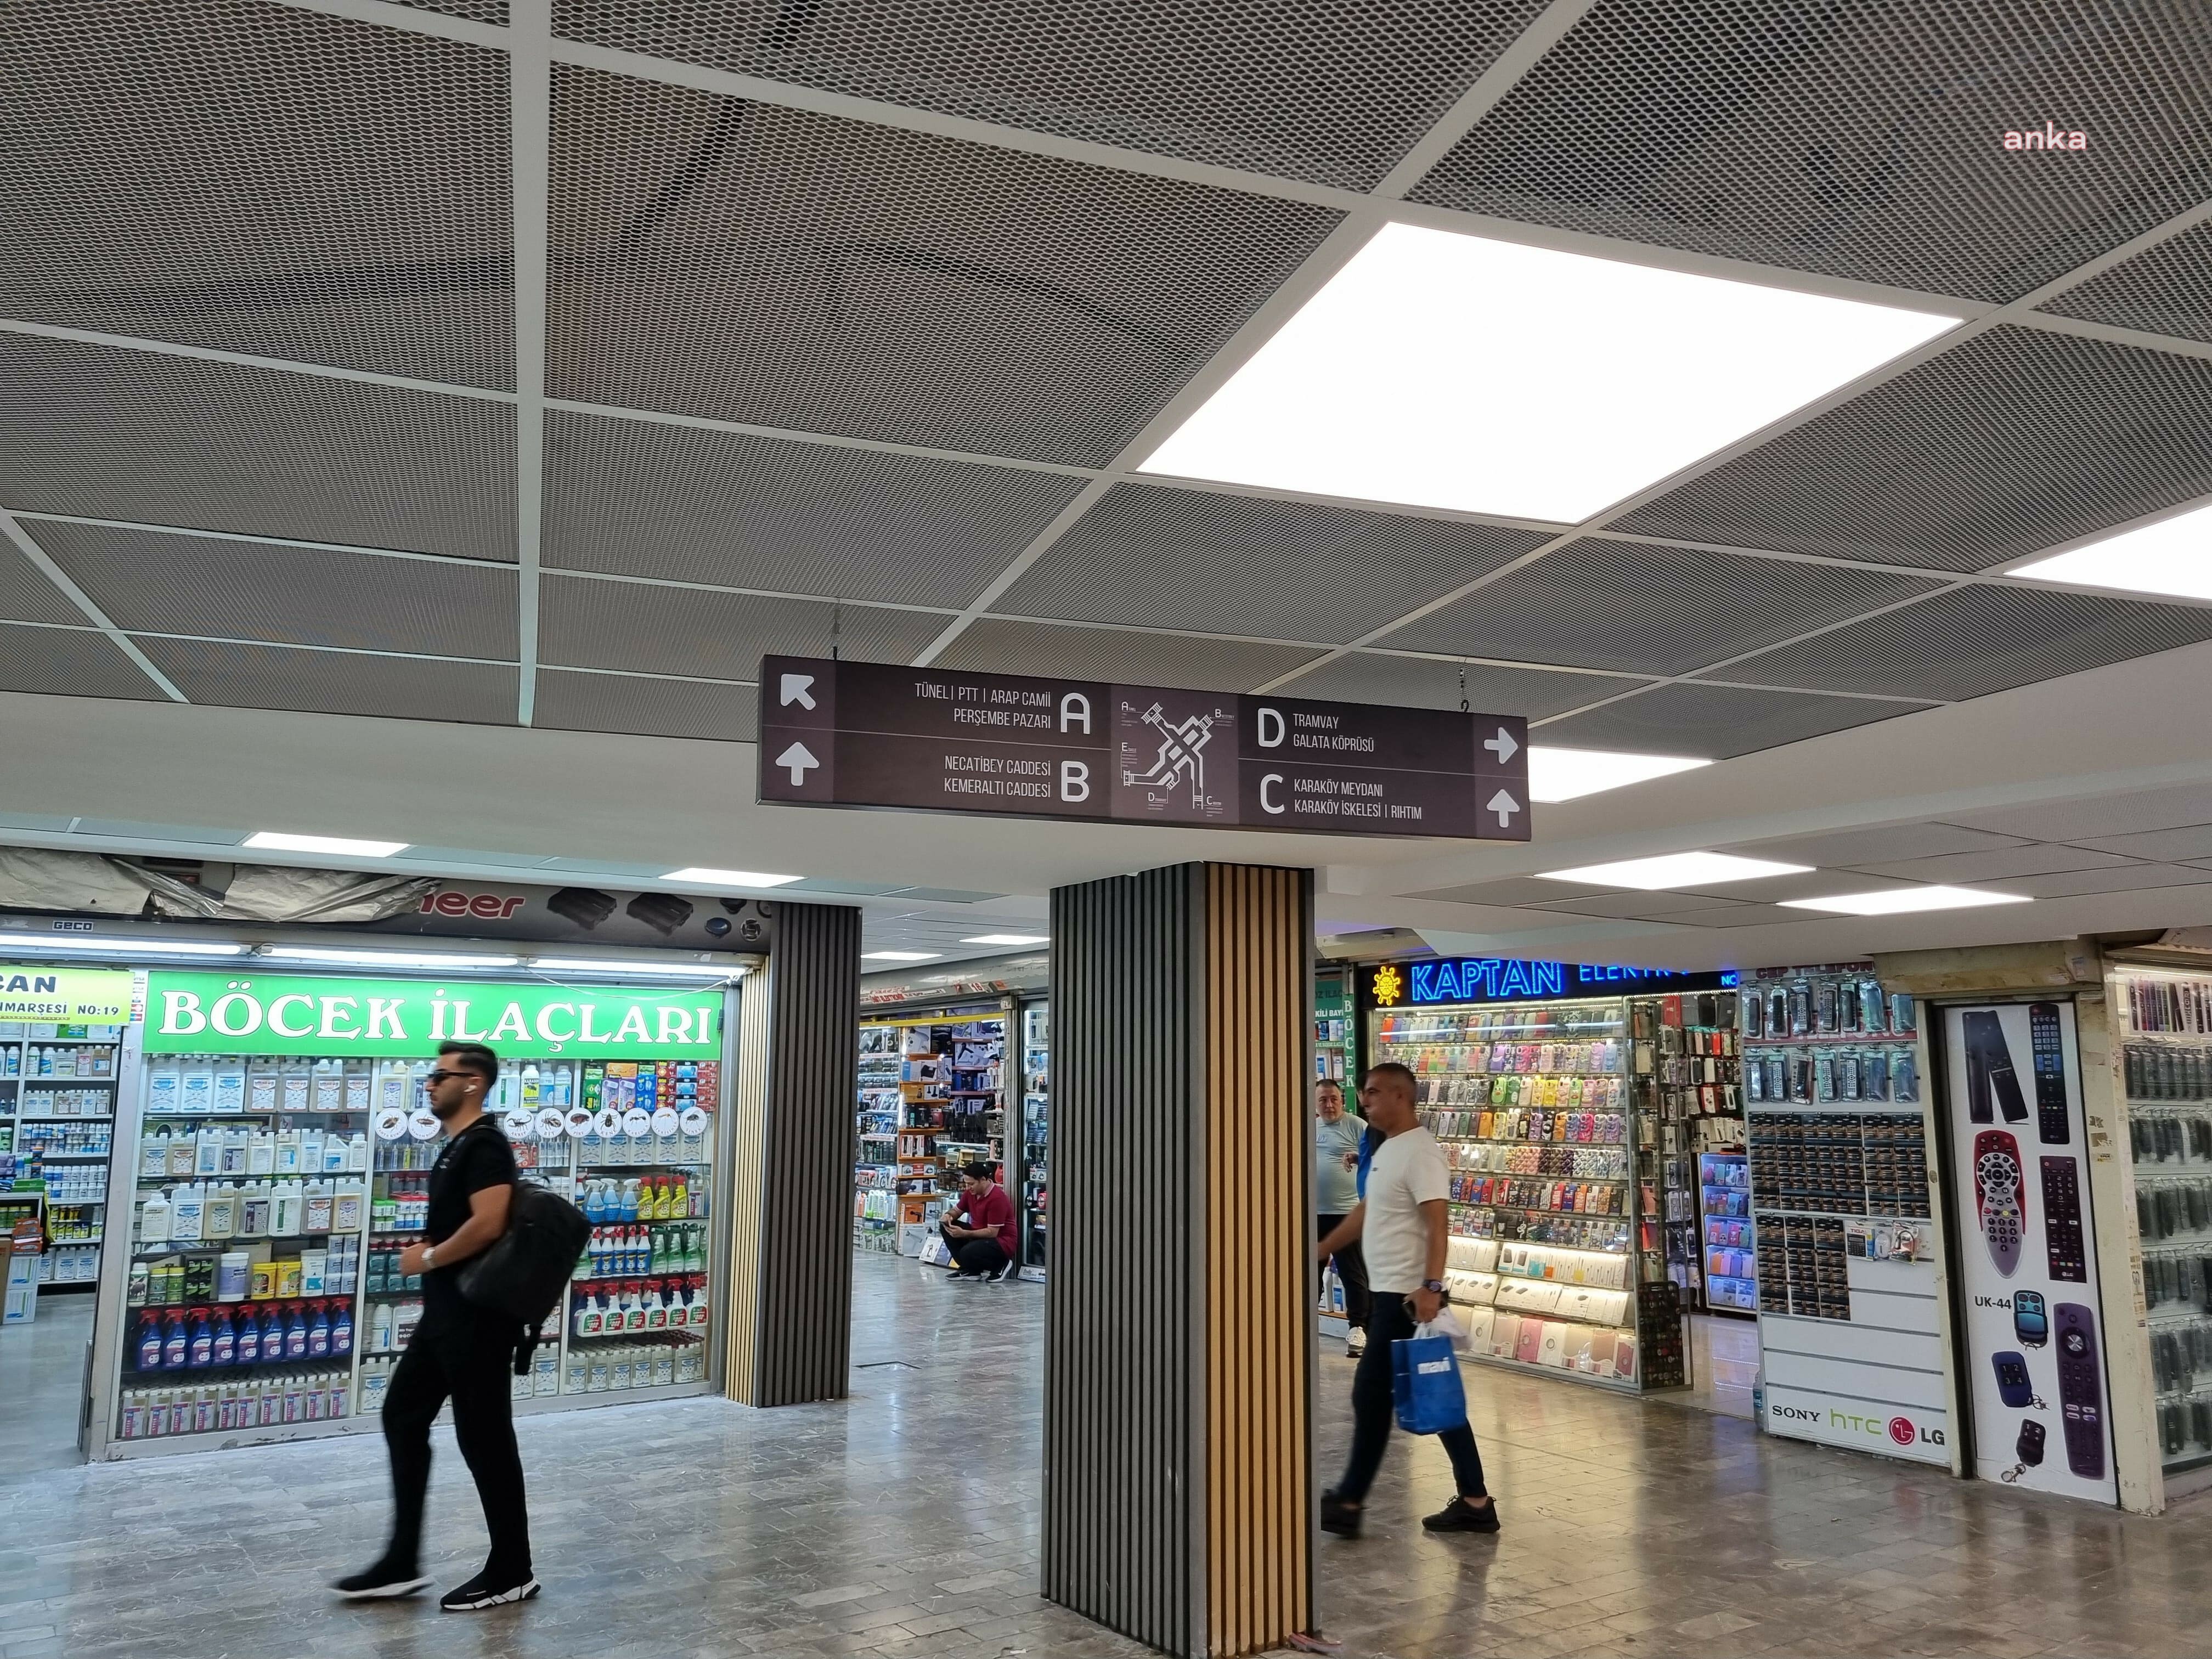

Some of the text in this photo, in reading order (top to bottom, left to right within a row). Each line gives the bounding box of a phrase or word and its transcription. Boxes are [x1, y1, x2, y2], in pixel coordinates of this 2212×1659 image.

[915, 681, 949, 699] TÜNEL
[958, 687, 979, 702] PTT
[990, 690, 1019, 704] ARAP
[1022, 691, 1051, 707] CAMİİ
[954, 708, 1051, 729] PERŞEMBE PAZARI
[1060, 692, 1090, 735] A
[1293, 713, 1339, 729] TRAMVAY
[1257, 708, 1285, 748] D
[1293, 733, 1374, 752] GALATA KÖPRÜSÜ
[945, 755, 1051, 776] NECATİBEY CADDESİ
[944, 777, 1051, 798] KEMERALTI CADDESİ
[1060, 760, 1090, 802] B
[1294, 778, 1383, 797] KARAKÖY MEYDANI
[1260, 774, 1285, 814] C
[1294, 799, 1340, 815] KARAKÖY
[1341, 800, 1381, 817] İSKELESİ
[1391, 805, 1422, 820] RIHTIM
[0, 975, 57, 993] AN
[1412, 959, 1562, 1001] KAPTAN
[157, 980, 712, 1052] BÖCEK İLAÇLARI
[1344, 1000, 1355, 1087] BÖCEK
[1975, 1295, 2012, 1310] UK-44
[1772, 1406, 1821, 1422] SONY
[1920, 1427, 1945, 1446] LG
